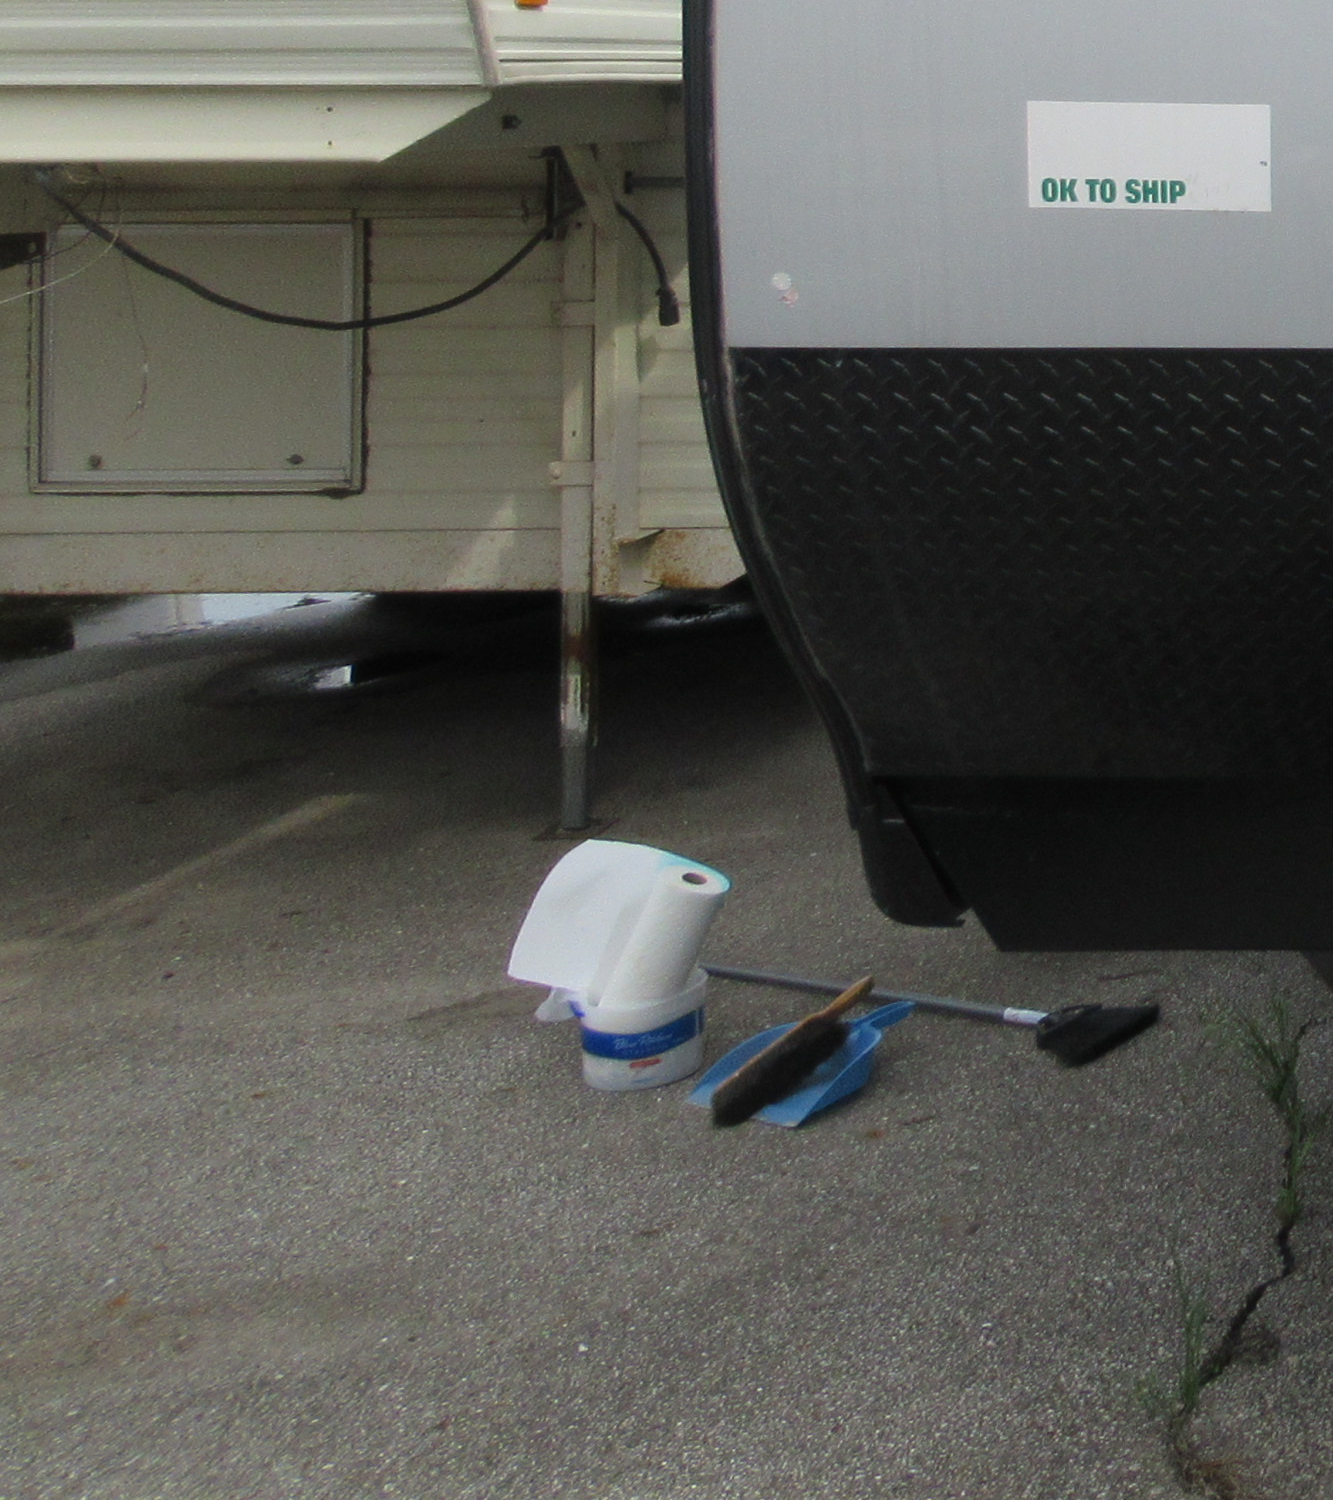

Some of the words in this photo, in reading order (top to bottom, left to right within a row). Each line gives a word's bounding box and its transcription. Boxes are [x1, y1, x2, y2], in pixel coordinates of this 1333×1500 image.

[1041, 177, 1077, 202] OK
[1085, 178, 1116, 203] TO
[1125, 179, 1186, 204] SHIP
